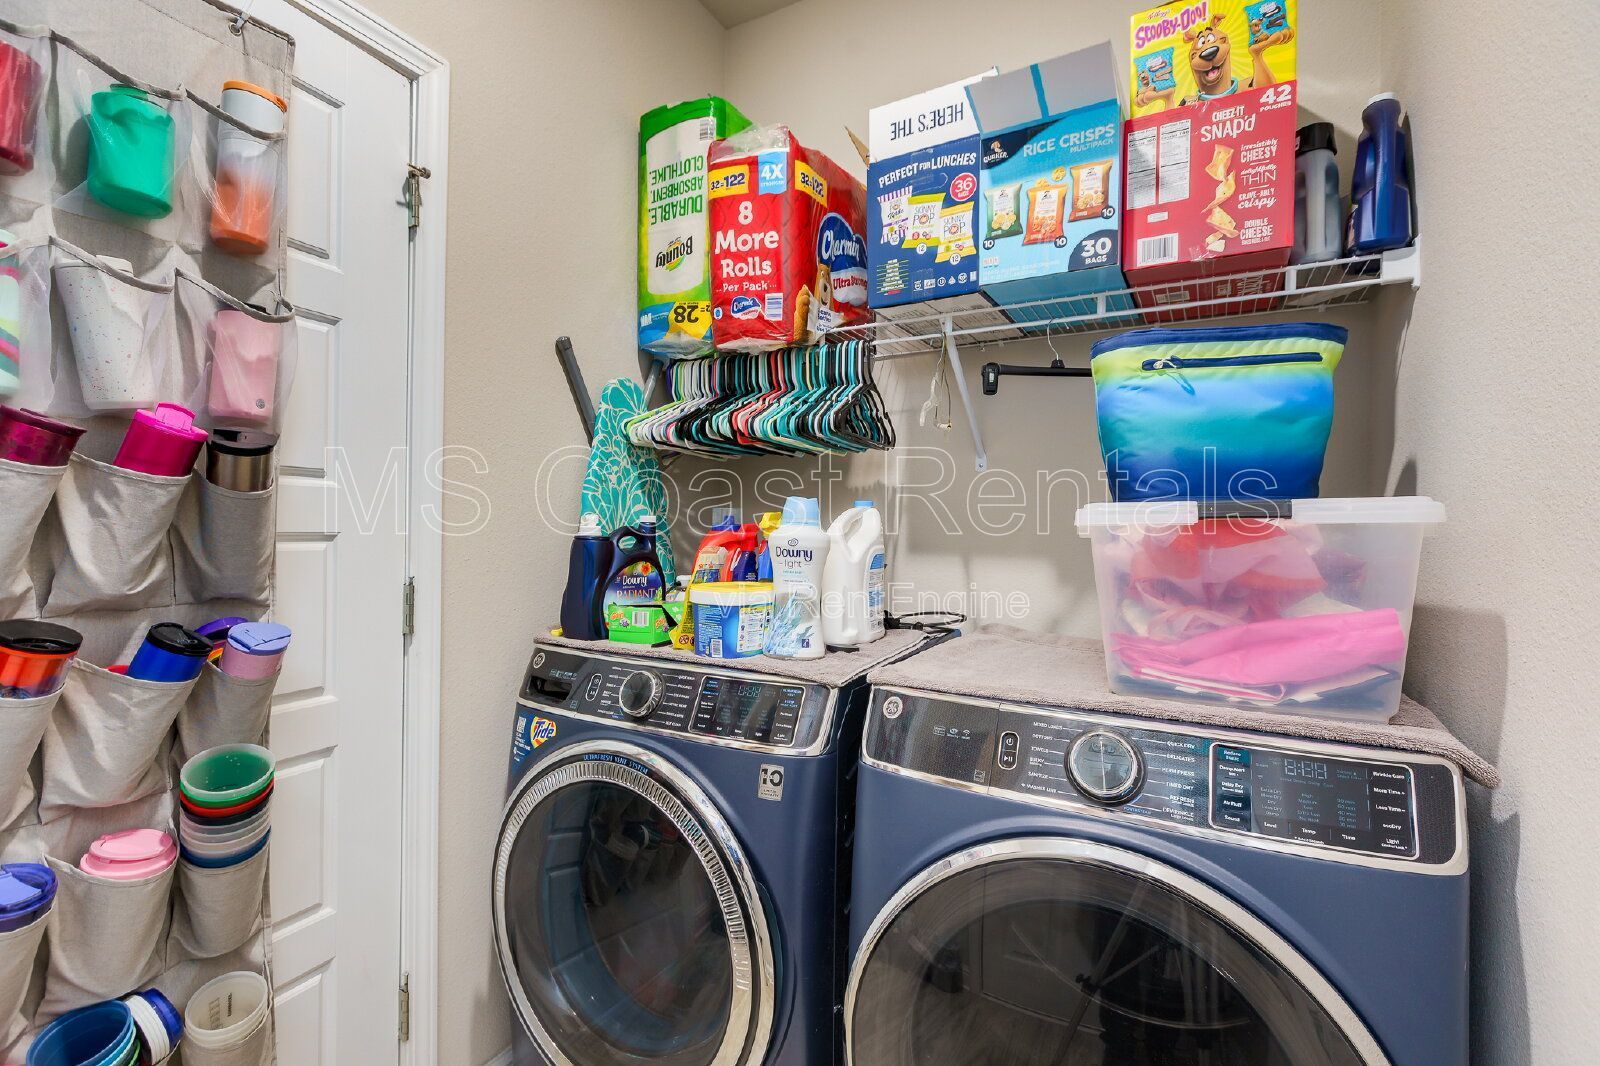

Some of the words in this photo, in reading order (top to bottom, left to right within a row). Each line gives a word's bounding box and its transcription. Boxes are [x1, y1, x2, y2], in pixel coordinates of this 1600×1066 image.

[1259, 84, 1292, 104] 42
[917, 102, 964, 133] HERE'S
[890, 118, 914, 141] THE
[1023, 138, 1056, 157] RICE
[1059, 123, 1115, 148] CRISPS
[1069, 138, 1114, 153] MULTIPACK
[1241, 144, 1277, 163] CHEESY
[649, 155, 704, 186] CLOTHLIKE.
[761, 164, 784, 180] 4X
[878, 162, 919, 189] PERFECT
[919, 162, 931, 171] FOR
[931, 152, 977, 170] LUNCHES
[1241, 170, 1276, 186] THIN
[650, 175, 704, 204] ABSORBENT.
[955, 177, 973, 193] 36
[648, 194, 703, 225] DURABLE.
[1237, 196, 1277, 209] crispy
[738, 200, 753, 225] 8
[1102, 208, 1114, 217] 10
[1244, 217, 1269, 229] DOUBLE
[1240, 225, 1274, 240] CHEESE
[714, 229, 780, 255] More
[821, 230, 860, 261] Charmin
[984, 239, 994, 248] 10
[1056, 238, 1066, 246] 10
[1081, 236, 1112, 257] 30
[655, 235, 694, 269] Bounty
[1085, 254, 1108, 264] BAGS
[720, 257, 772, 278] Rolls
[722, 283, 739, 293] Per
[742, 281, 768, 291] Pack
[833, 277, 851, 290] Ultra
[775, 545, 813, 562] Downy
[784, 558, 802, 568] light
[622, 575, 647, 587] Downy
[533, 720, 555, 741] Tide
